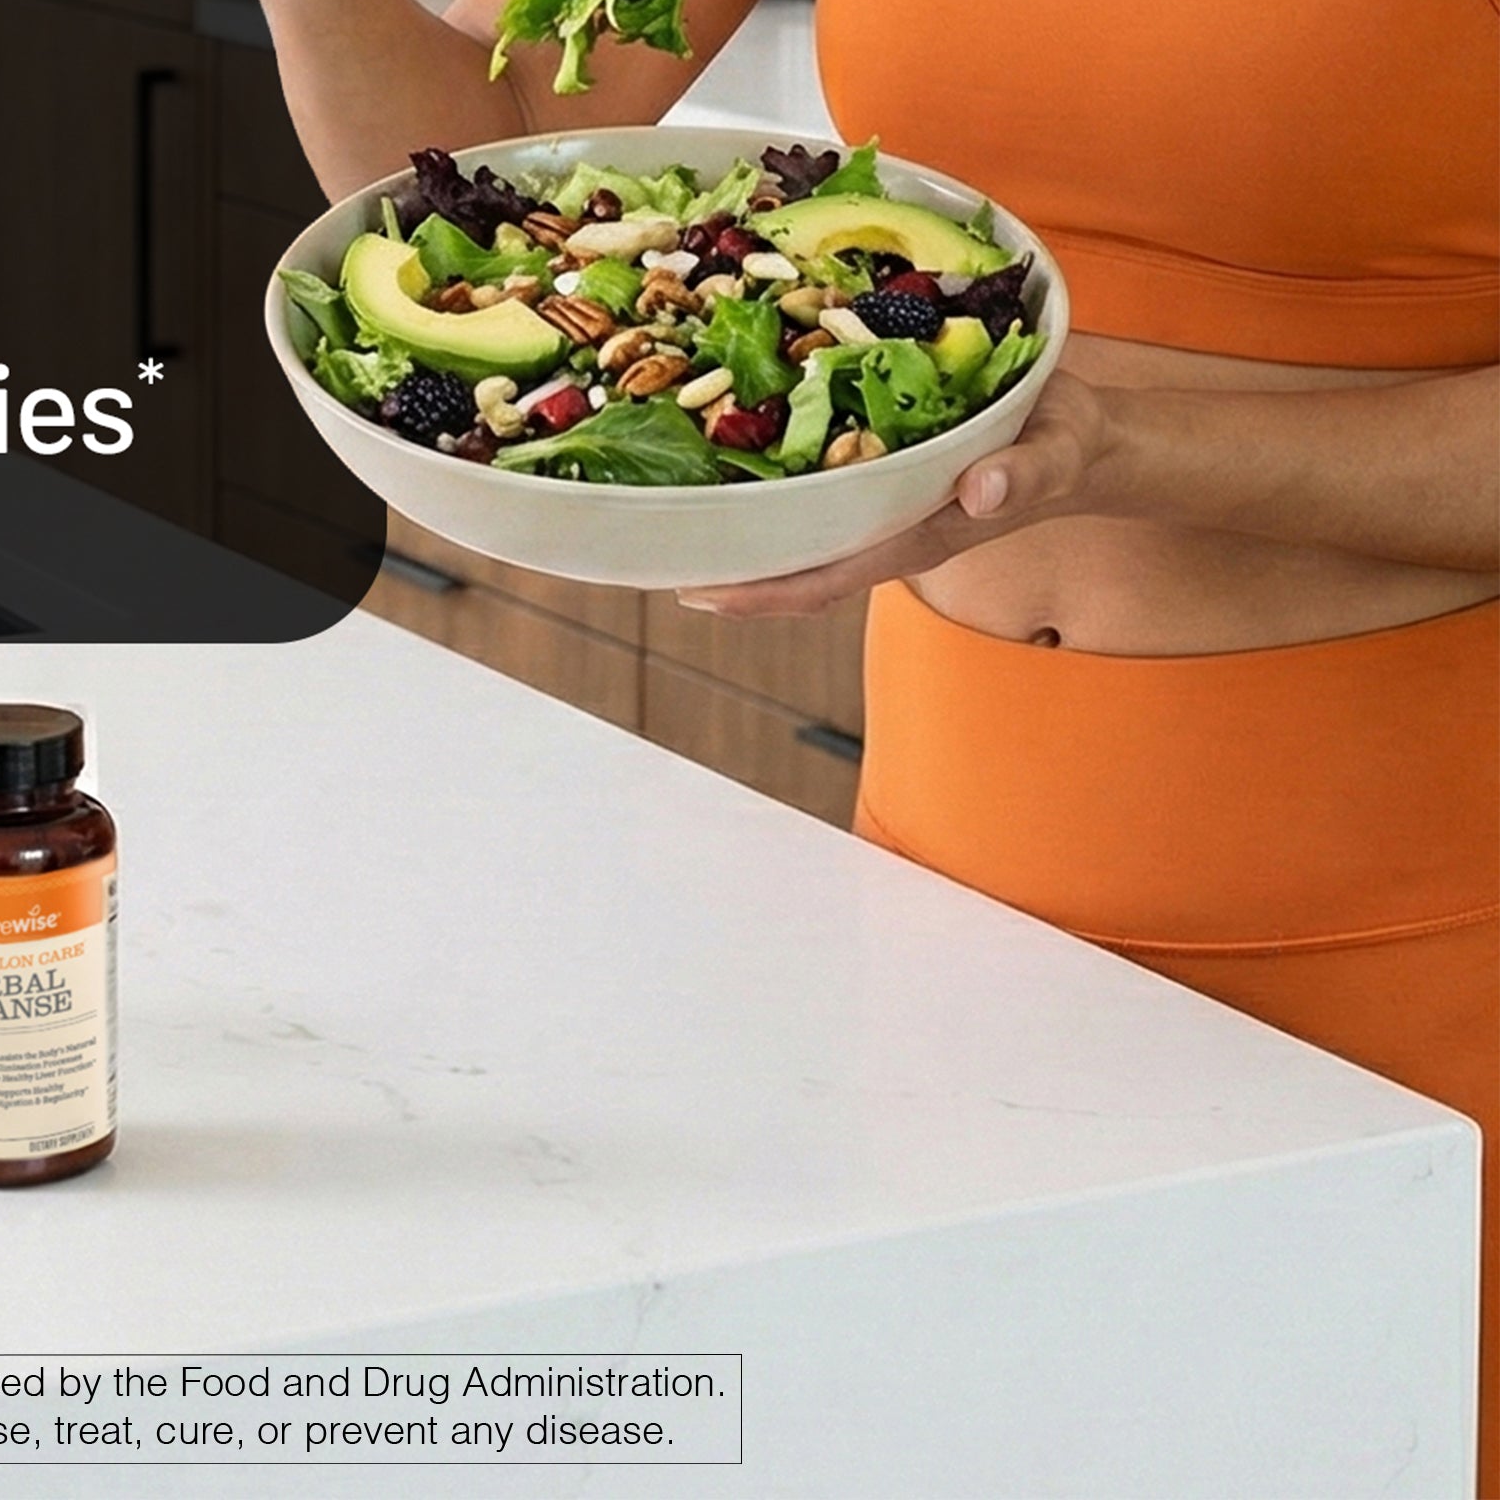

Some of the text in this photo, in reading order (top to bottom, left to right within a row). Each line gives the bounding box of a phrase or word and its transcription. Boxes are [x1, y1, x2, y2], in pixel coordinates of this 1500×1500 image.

[39, 943, 85, 966] CARE
[24, 1050, 37, 1060] the
[65, 1036, 97, 1052] Natural
